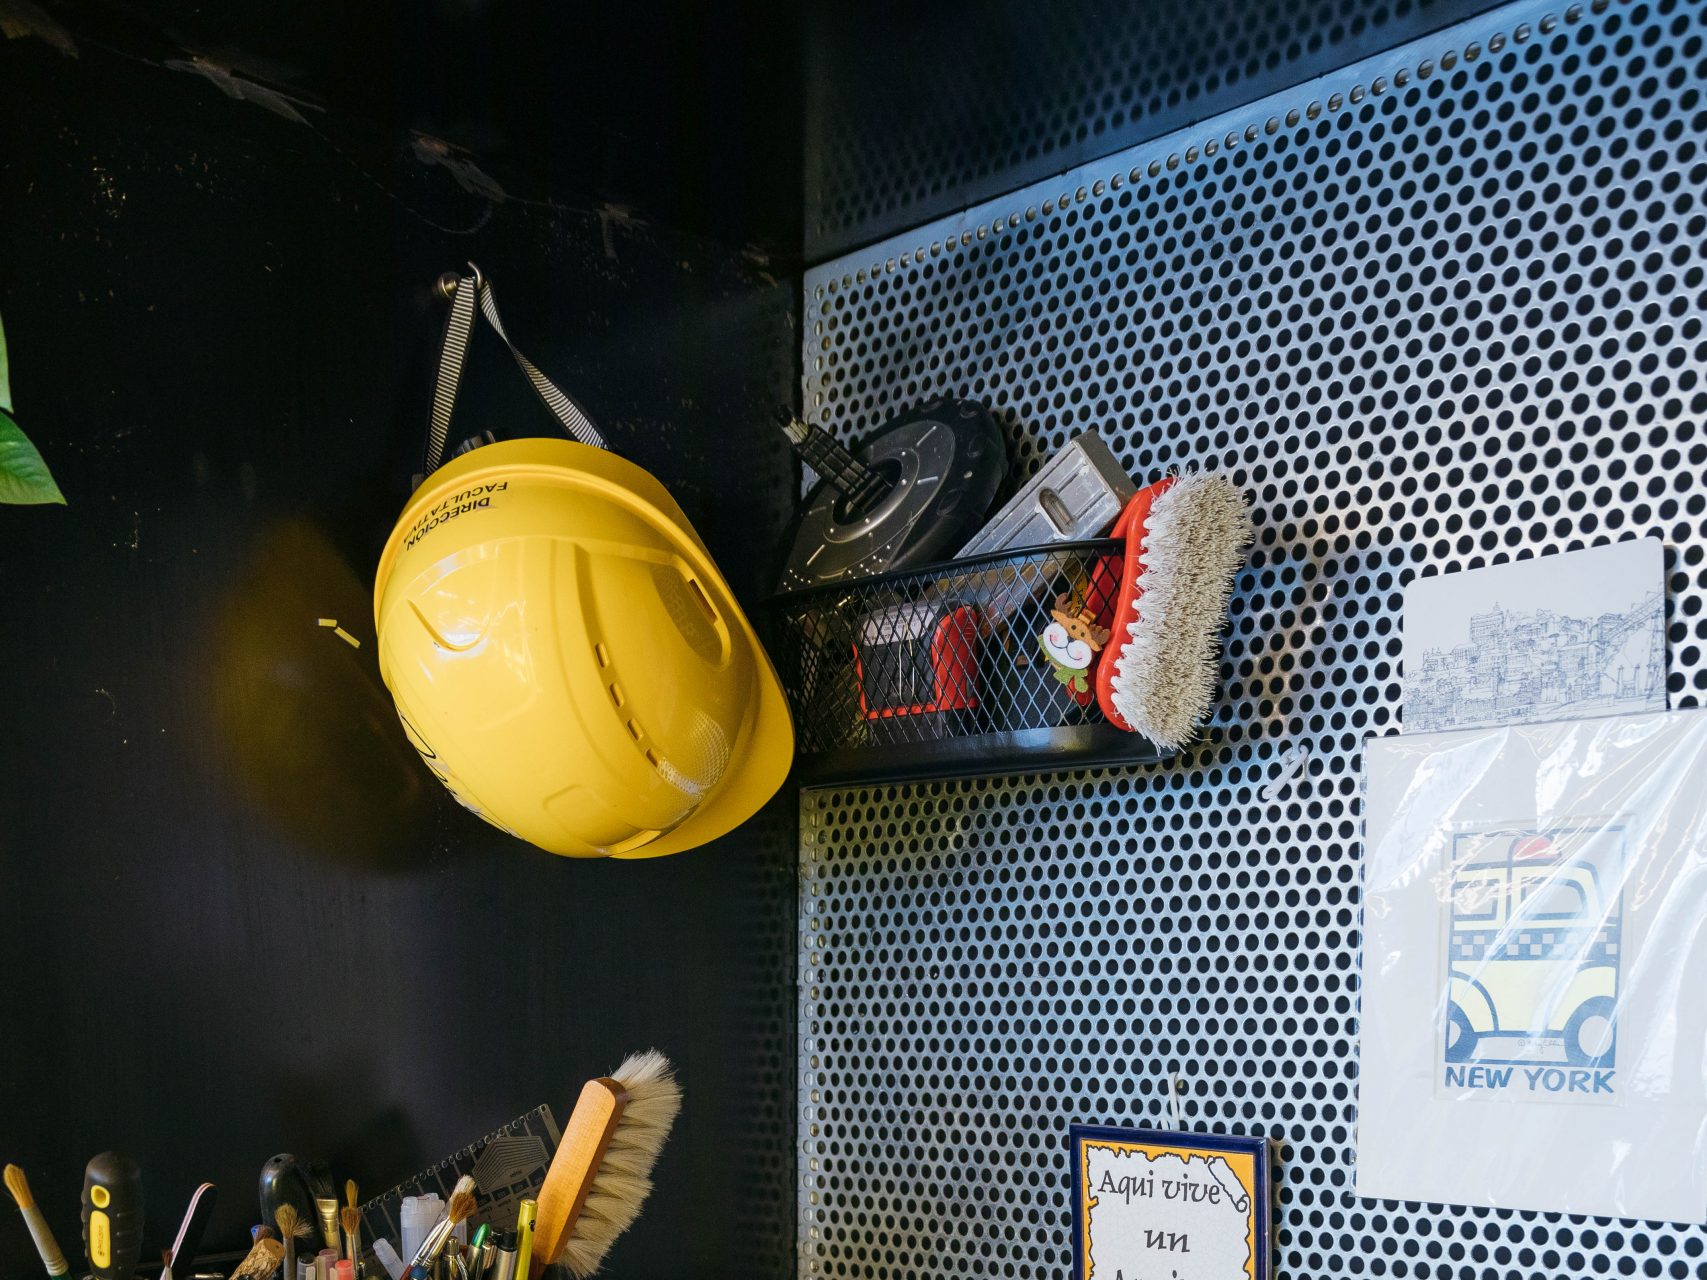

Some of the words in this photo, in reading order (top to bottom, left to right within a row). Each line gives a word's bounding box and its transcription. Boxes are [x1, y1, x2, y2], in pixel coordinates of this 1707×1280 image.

[403, 481, 508, 543] FACULTATIVA
[406, 496, 490, 551] DIRECCIÓN
[1445, 1065, 1514, 1089] NEW
[1523, 1067, 1616, 1094] YORK
[1097, 1169, 1154, 1205] Aqui
[1161, 1173, 1221, 1205] vive
[1143, 1229, 1190, 1253] un
